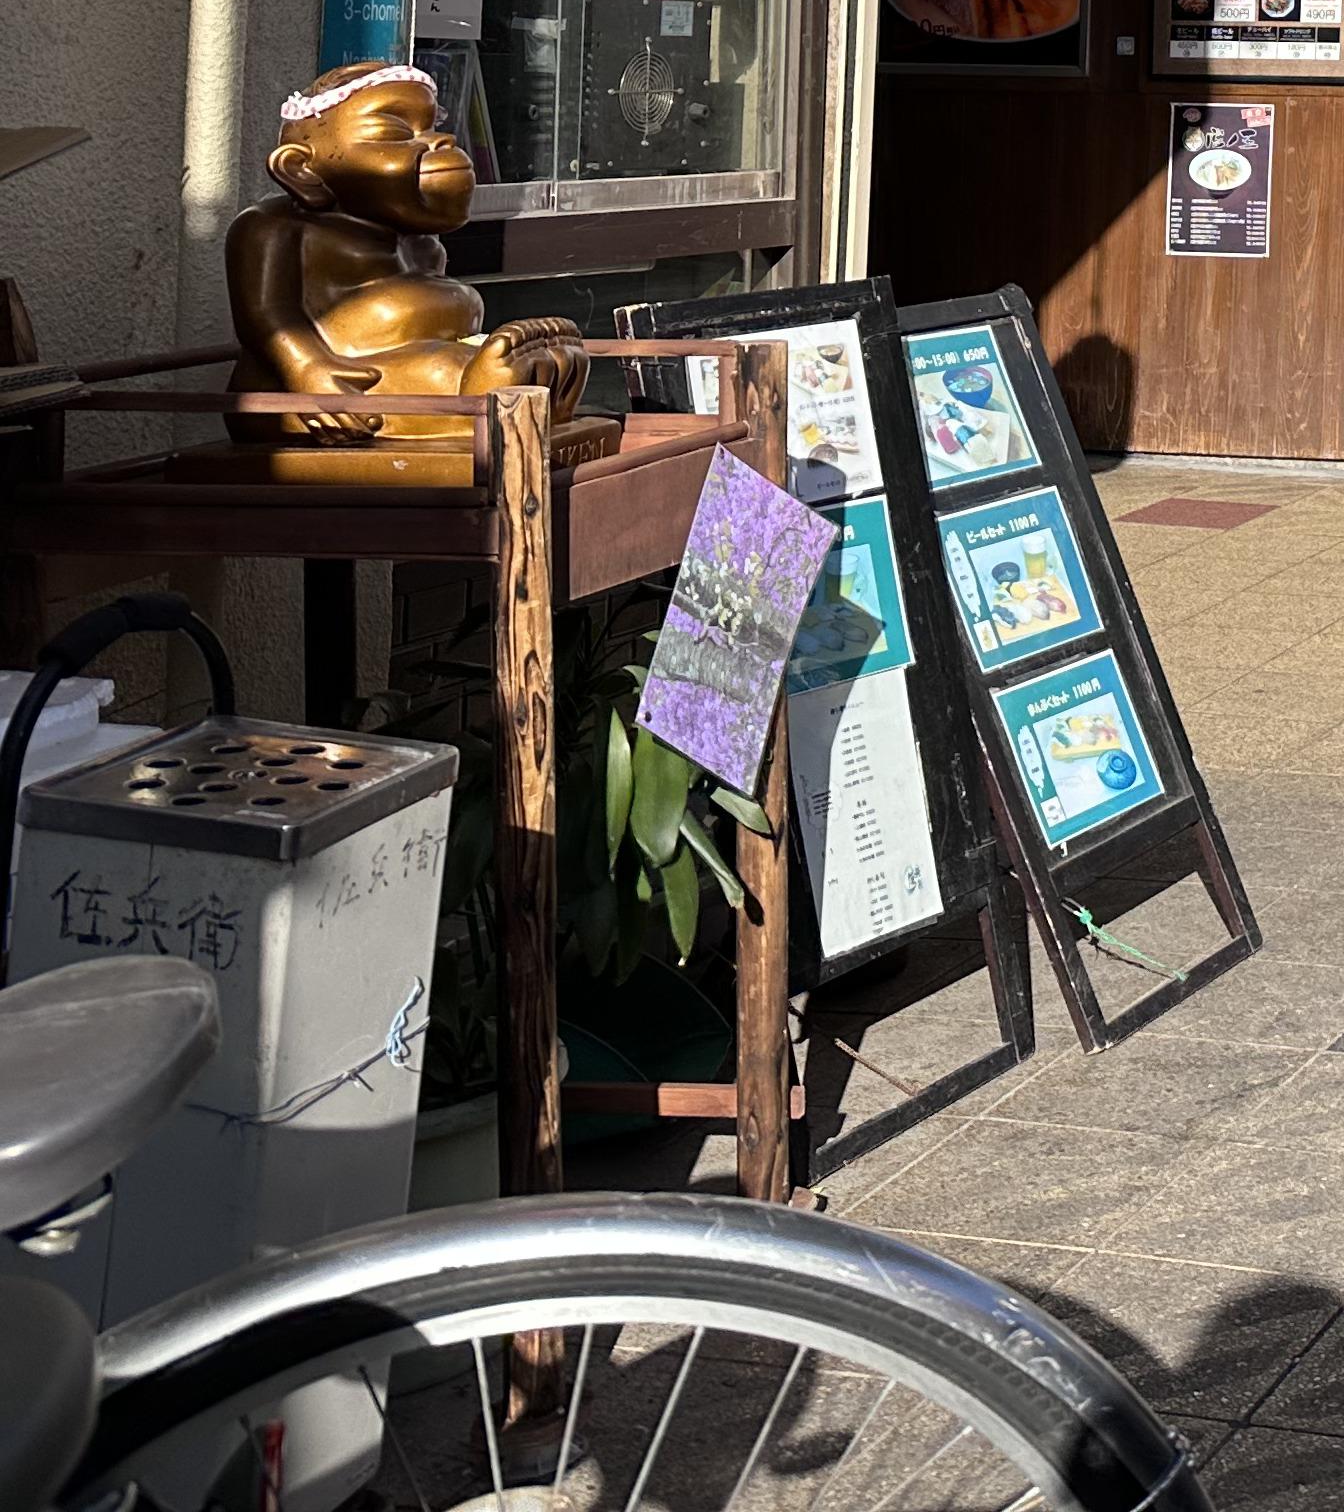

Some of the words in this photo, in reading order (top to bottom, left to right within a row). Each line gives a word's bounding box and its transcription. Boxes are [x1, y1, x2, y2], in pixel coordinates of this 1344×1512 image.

[1220, 8, 1250, 18] 500円
[1306, 9, 1336, 19] 490円
[1008, 513, 1039, 533] 1100円
[1072, 677, 1101, 699] 1100円
